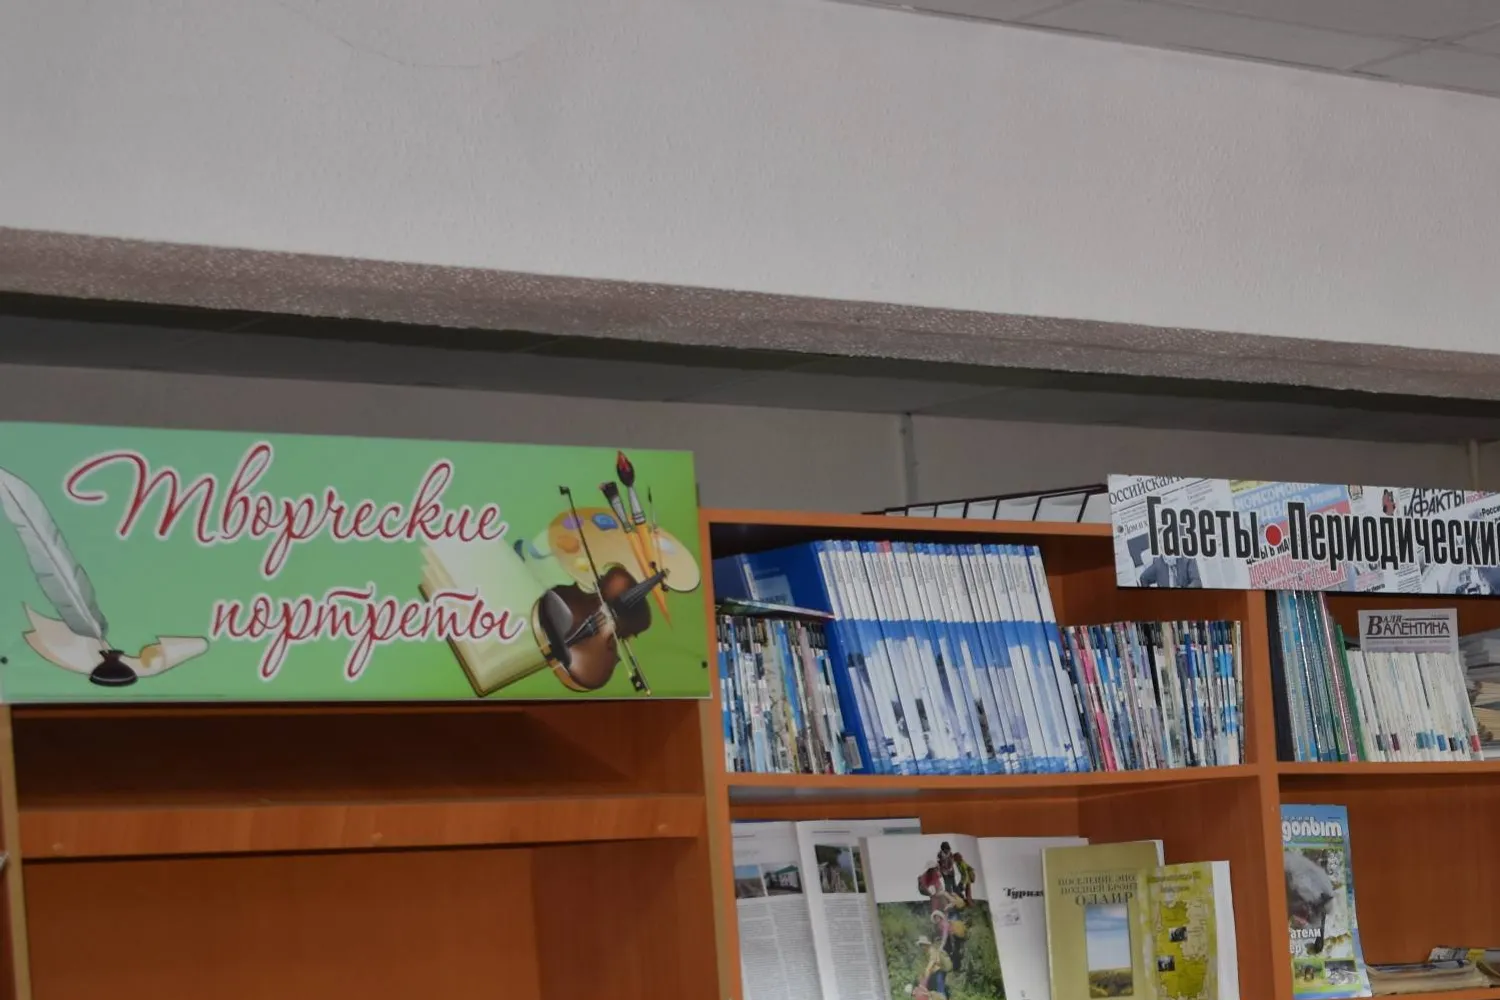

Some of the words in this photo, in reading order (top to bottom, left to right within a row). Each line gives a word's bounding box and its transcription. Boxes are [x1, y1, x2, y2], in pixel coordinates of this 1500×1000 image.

[66, 443, 509, 576] Творческие
[1147, 496, 1260, 559] Газеты
[212, 586, 526, 680] портреты
